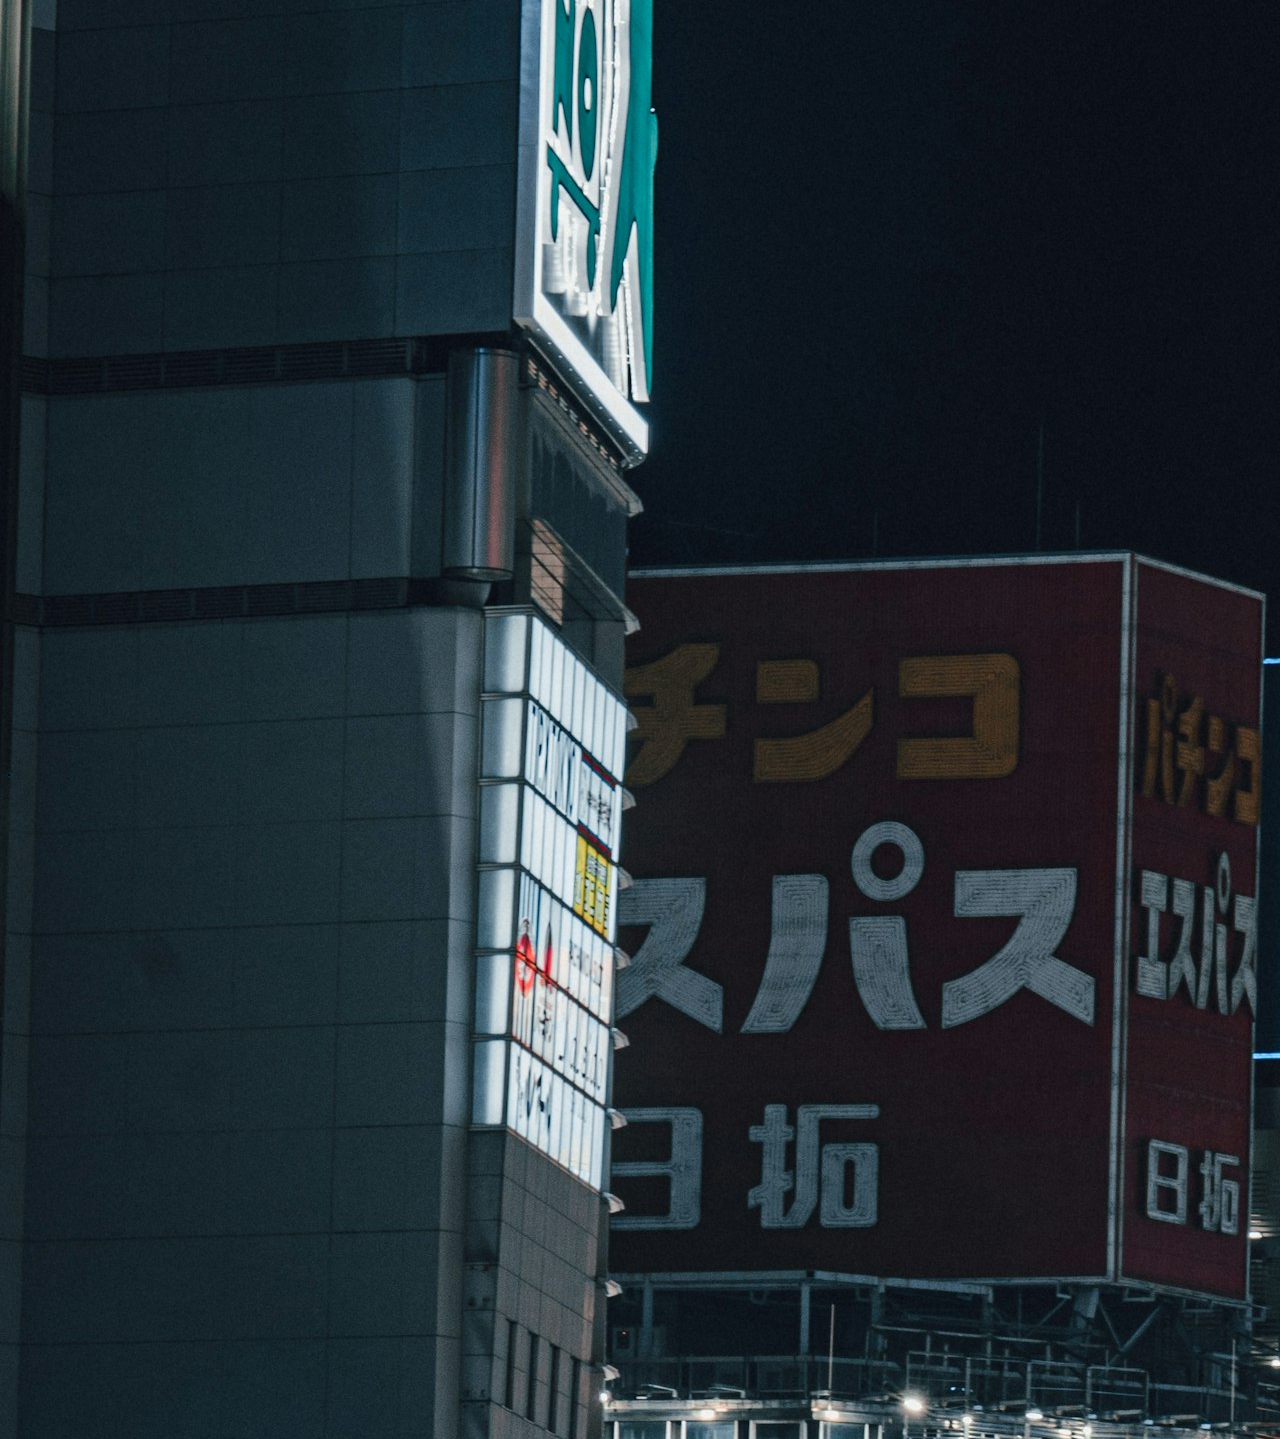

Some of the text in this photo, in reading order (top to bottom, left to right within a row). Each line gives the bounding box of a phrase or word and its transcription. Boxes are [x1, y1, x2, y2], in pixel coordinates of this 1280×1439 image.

[620, 642, 1020, 783] チンコ
[1142, 669, 1262, 827] パチンコ
[612, 821, 1097, 1033] スパス
[1136, 849, 1258, 1018] エスパス
[608, 1103, 880, 1230] 日拓
[1146, 1138, 1241, 1236] 日拓
